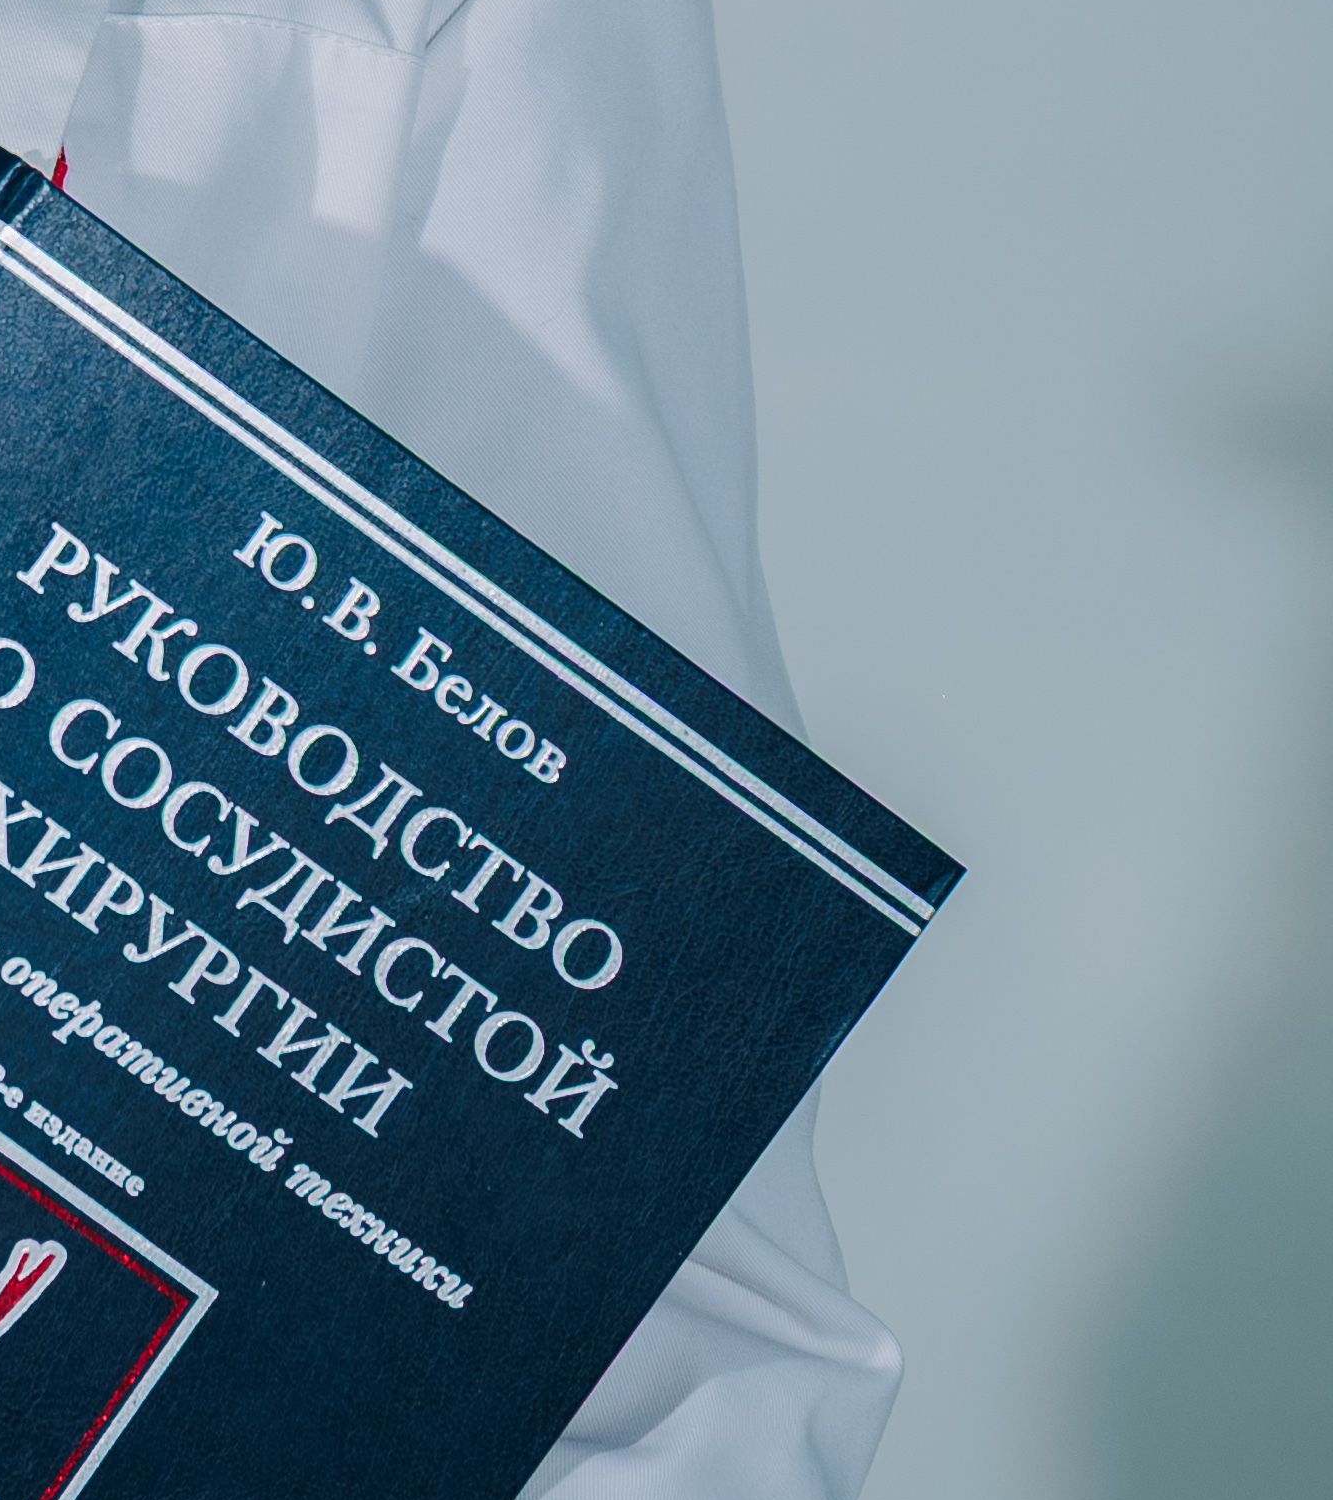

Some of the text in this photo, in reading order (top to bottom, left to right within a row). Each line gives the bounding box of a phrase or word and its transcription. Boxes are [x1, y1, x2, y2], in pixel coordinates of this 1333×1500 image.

[15, 521, 624, 990] РУКОВОДСТВО
[232, 509, 568, 784] Ю. В. Белов
[47, 698, 620, 1139] СОСУДИСТОЙ
[0, 956, 295, 1173] оперативной
[284, 1163, 475, 1309] техники
[22, 1100, 146, 1197] издание
